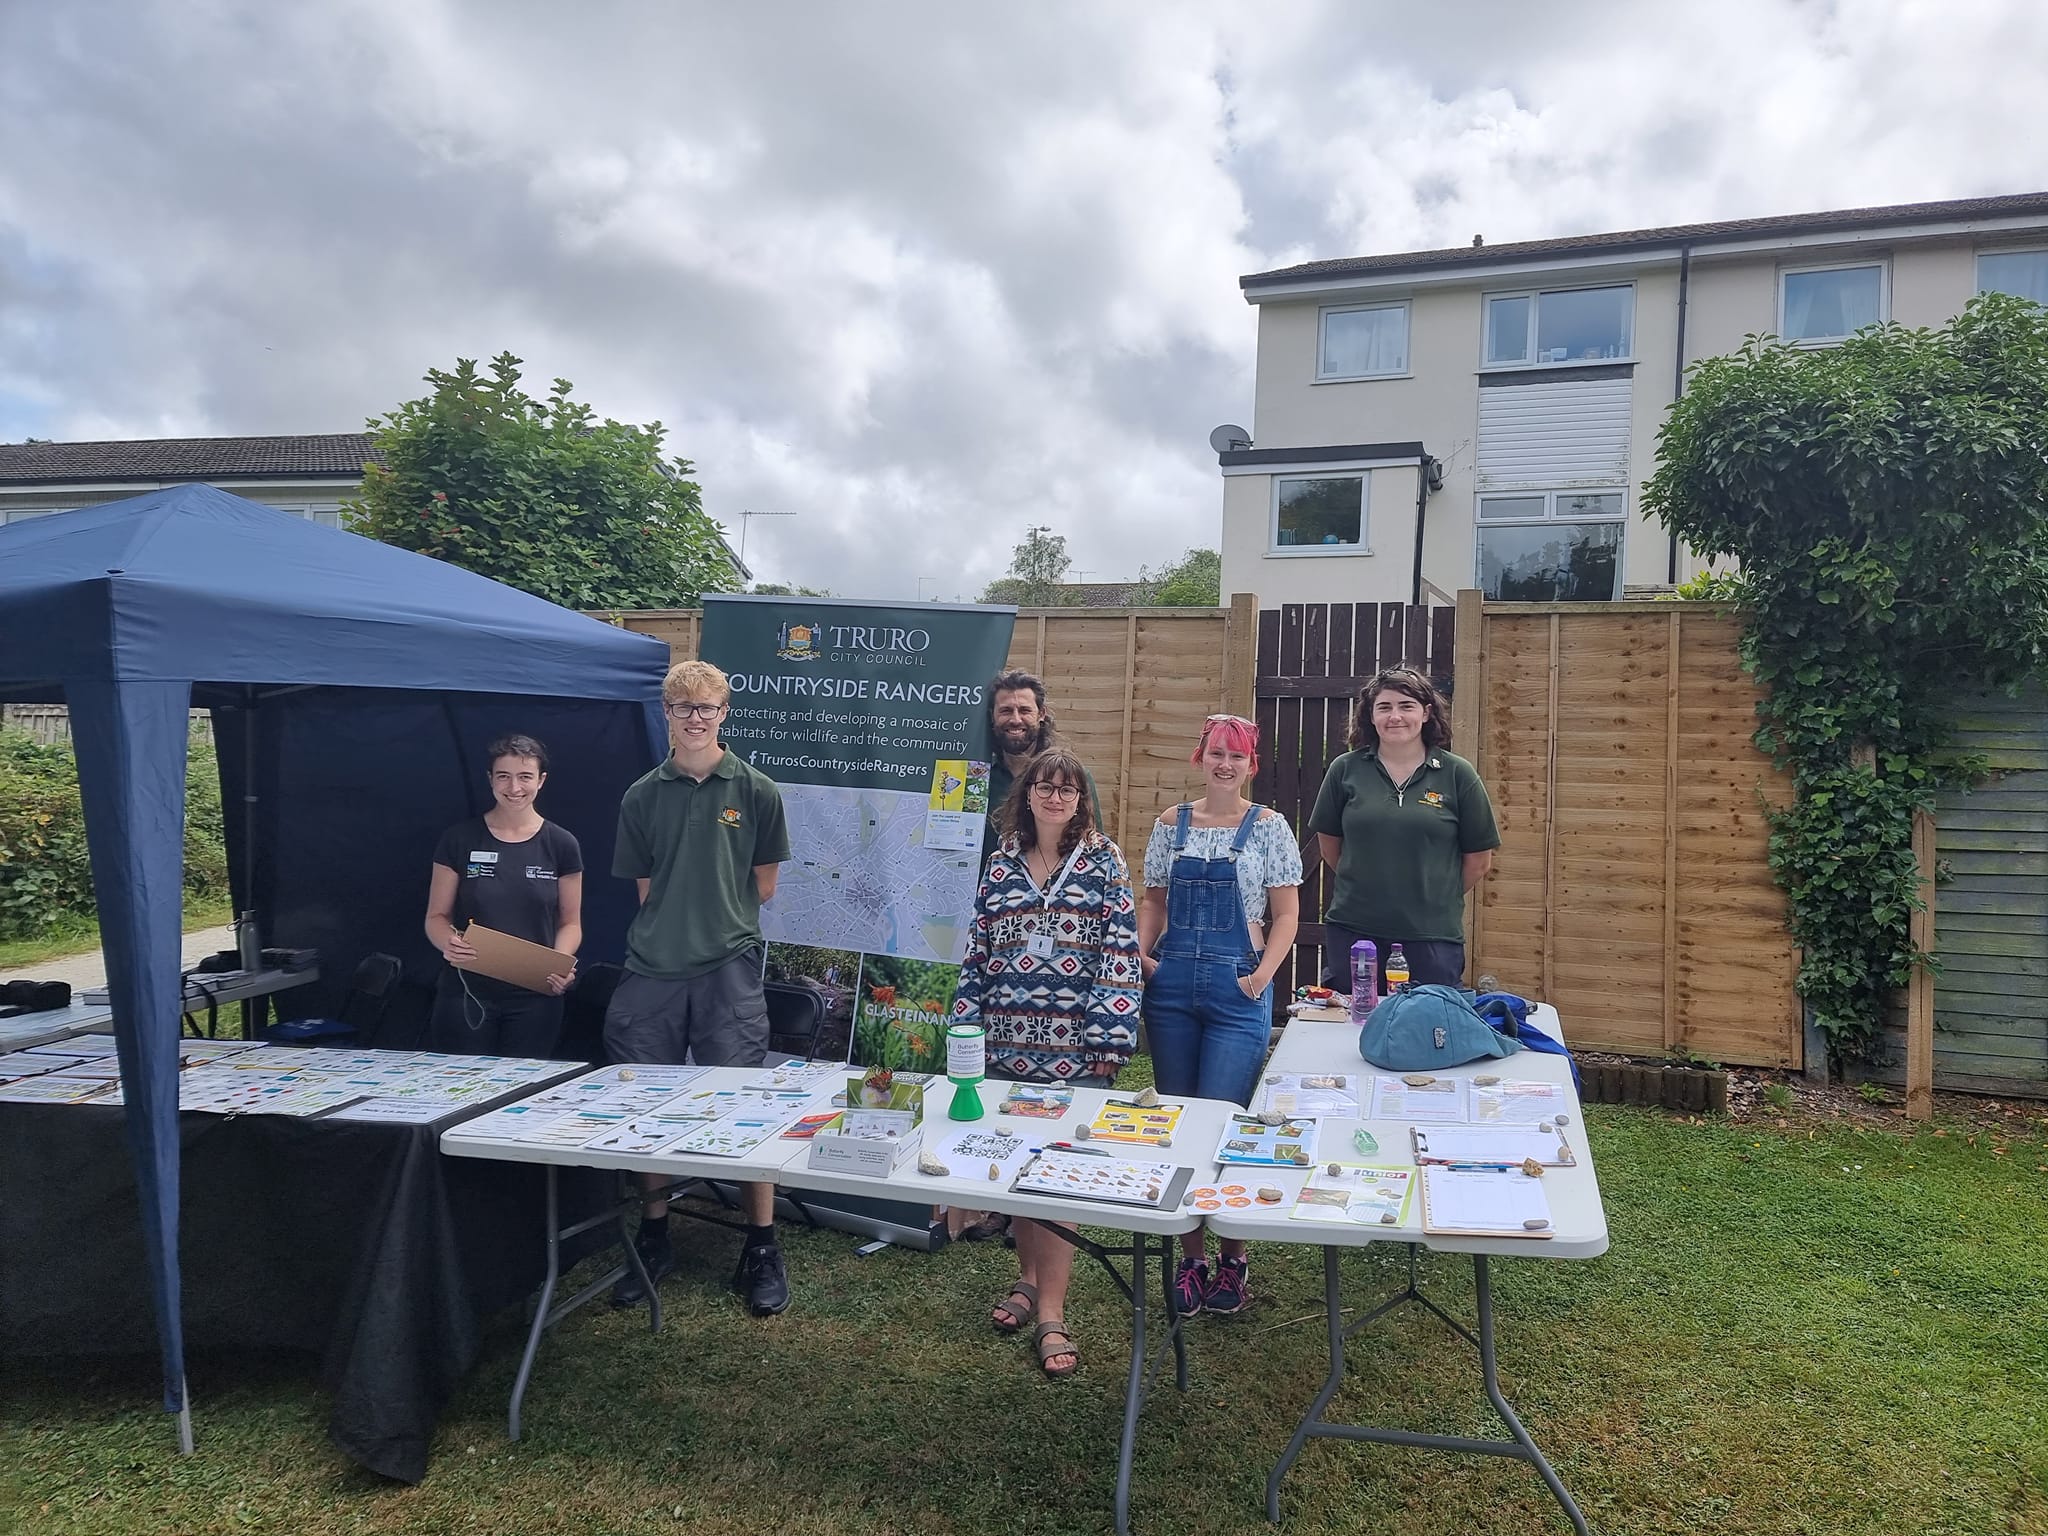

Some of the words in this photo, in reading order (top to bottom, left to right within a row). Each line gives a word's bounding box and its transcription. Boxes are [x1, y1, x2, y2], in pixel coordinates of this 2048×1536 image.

[829, 625, 930, 654] TRURO
[830, 652, 860, 662] CITY
[866, 653, 926, 667] COUNCIL
[722, 672, 869, 699] OUNTRYSIDE
[875, 680, 983, 705] RANGERS
[790, 708, 813, 721] and
[816, 709, 886, 730] developing
[889, 716, 898, 727] a
[901, 718, 950, 731] mosaic
[953, 718, 969, 731] of
[770, 726, 788, 740] for
[791, 728, 839, 744] wildlife
[842, 731, 864, 745] and
[867, 732, 889, 746] the
[892, 737, 968, 755] community
[760, 752, 928, 778] TrurosCountrysideRangers
